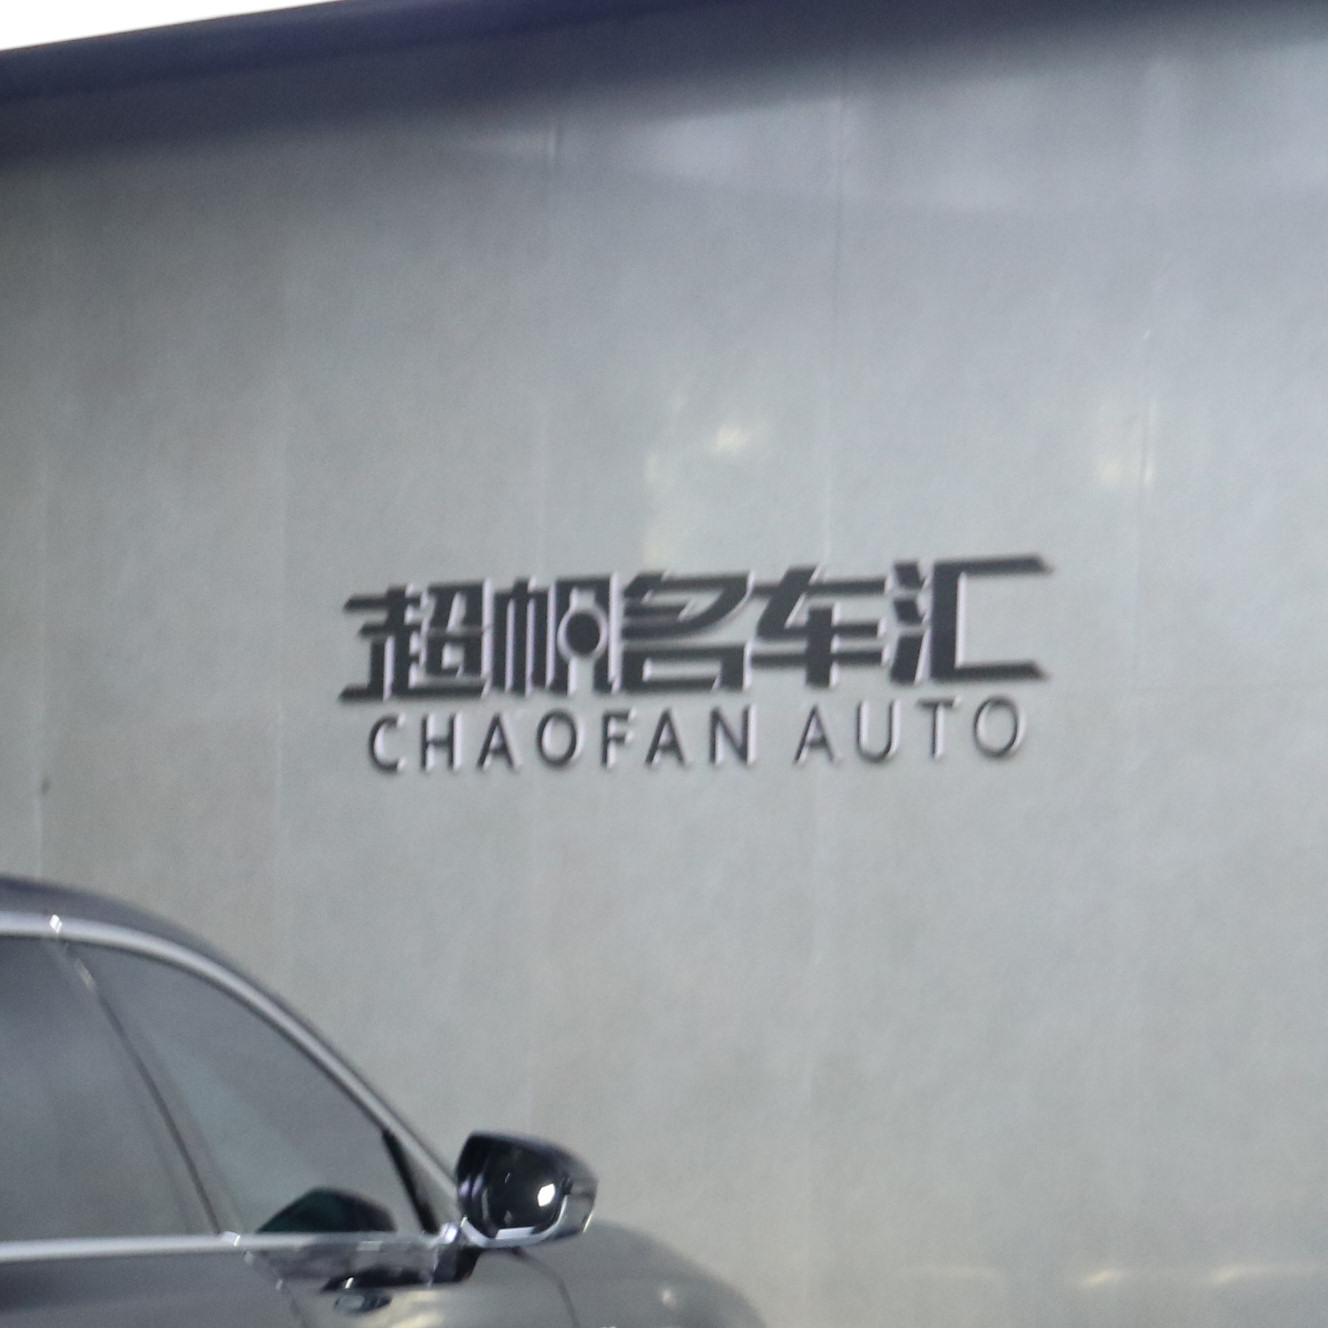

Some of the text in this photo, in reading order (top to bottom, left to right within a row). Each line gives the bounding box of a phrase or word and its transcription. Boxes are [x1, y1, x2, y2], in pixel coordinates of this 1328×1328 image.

[338, 555, 1050, 701] 超帆名车汇
[367, 696, 1028, 773] CHAOFAN AUTO
